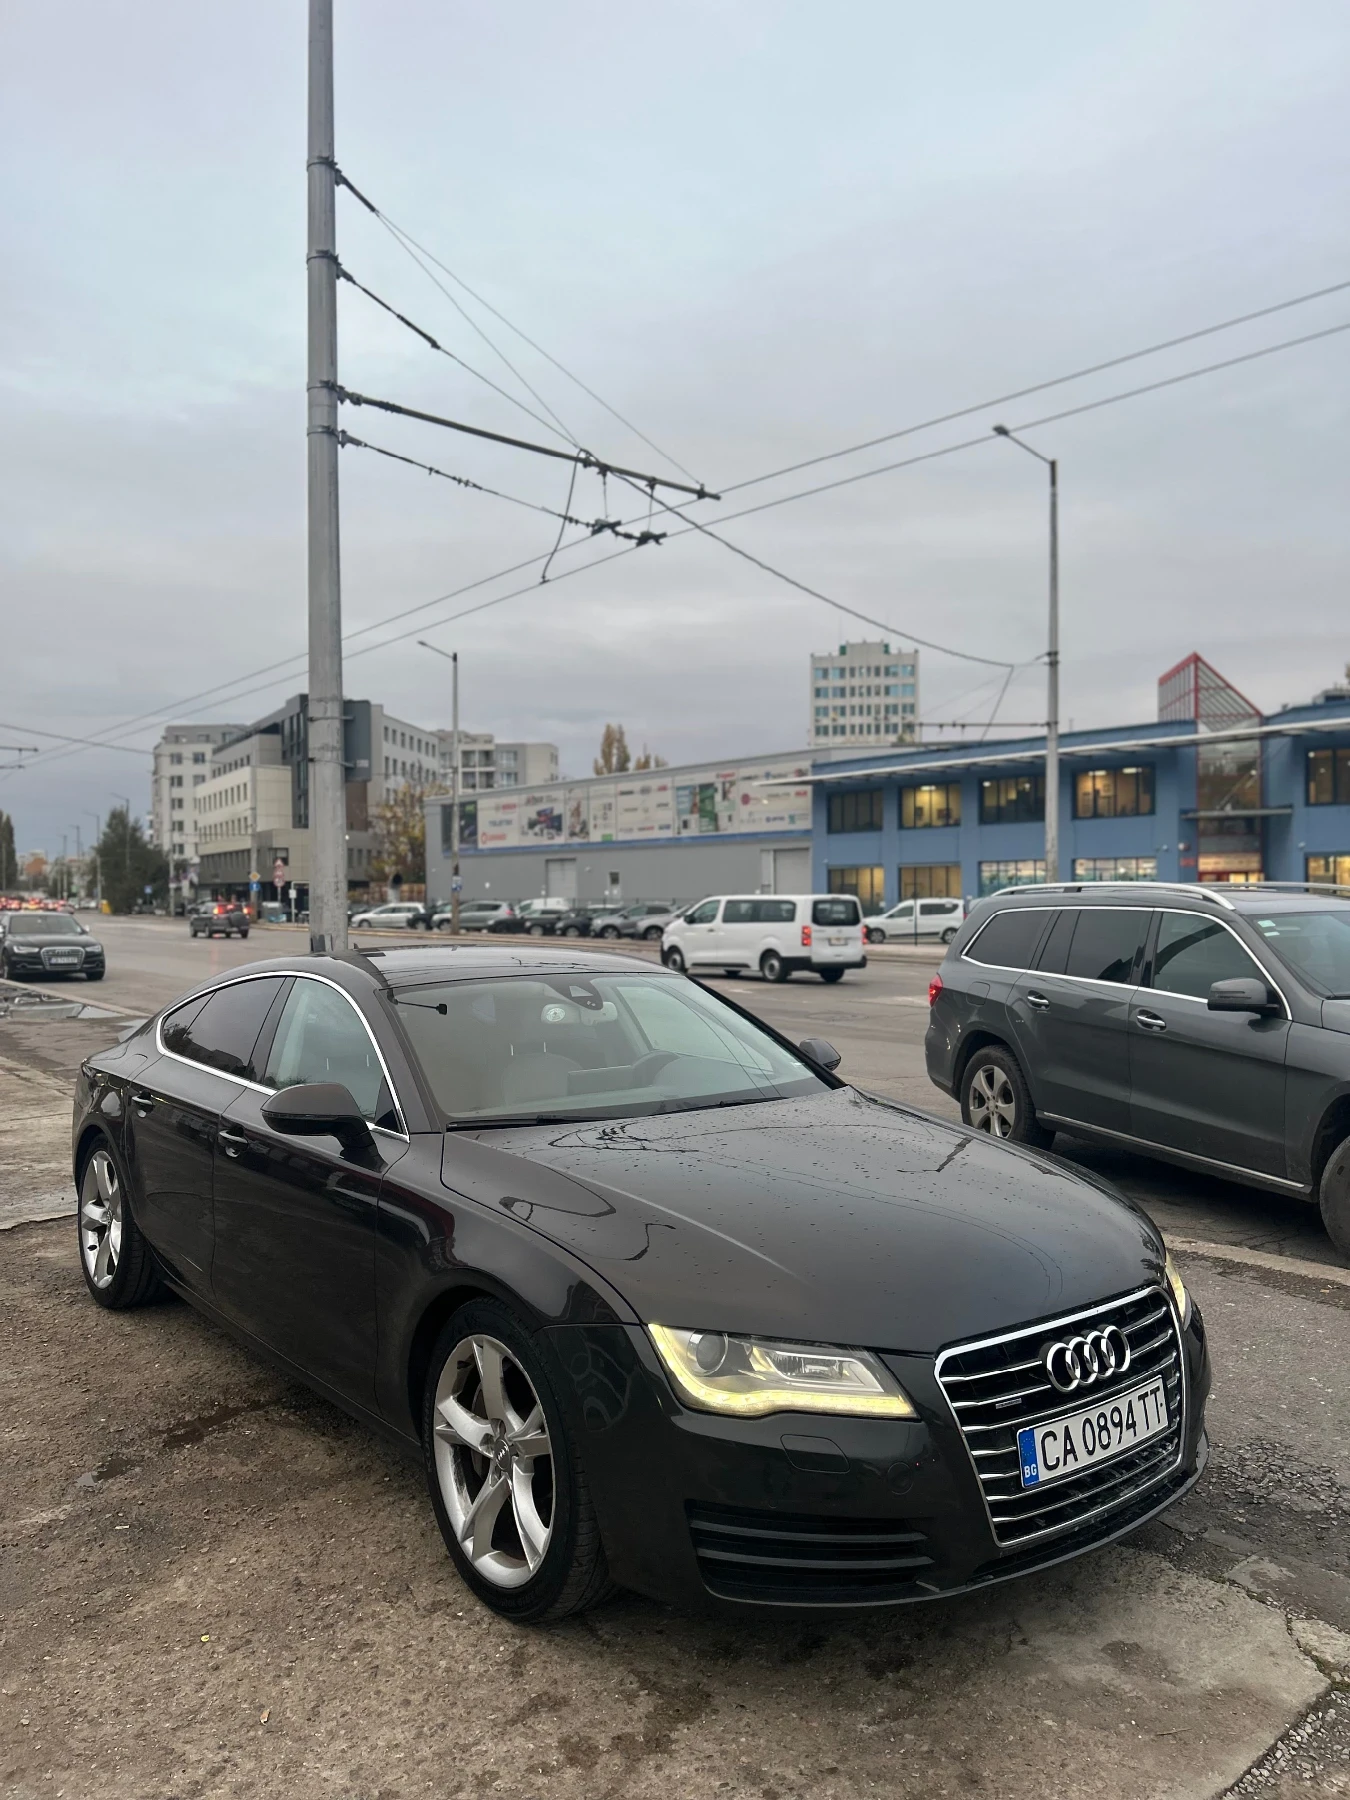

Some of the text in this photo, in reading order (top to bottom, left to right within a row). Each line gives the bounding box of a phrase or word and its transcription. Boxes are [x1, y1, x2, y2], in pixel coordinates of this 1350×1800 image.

[1040, 1386, 1160, 1471] CA 0894 TT
[1024, 1464, 1037, 1478] BG
